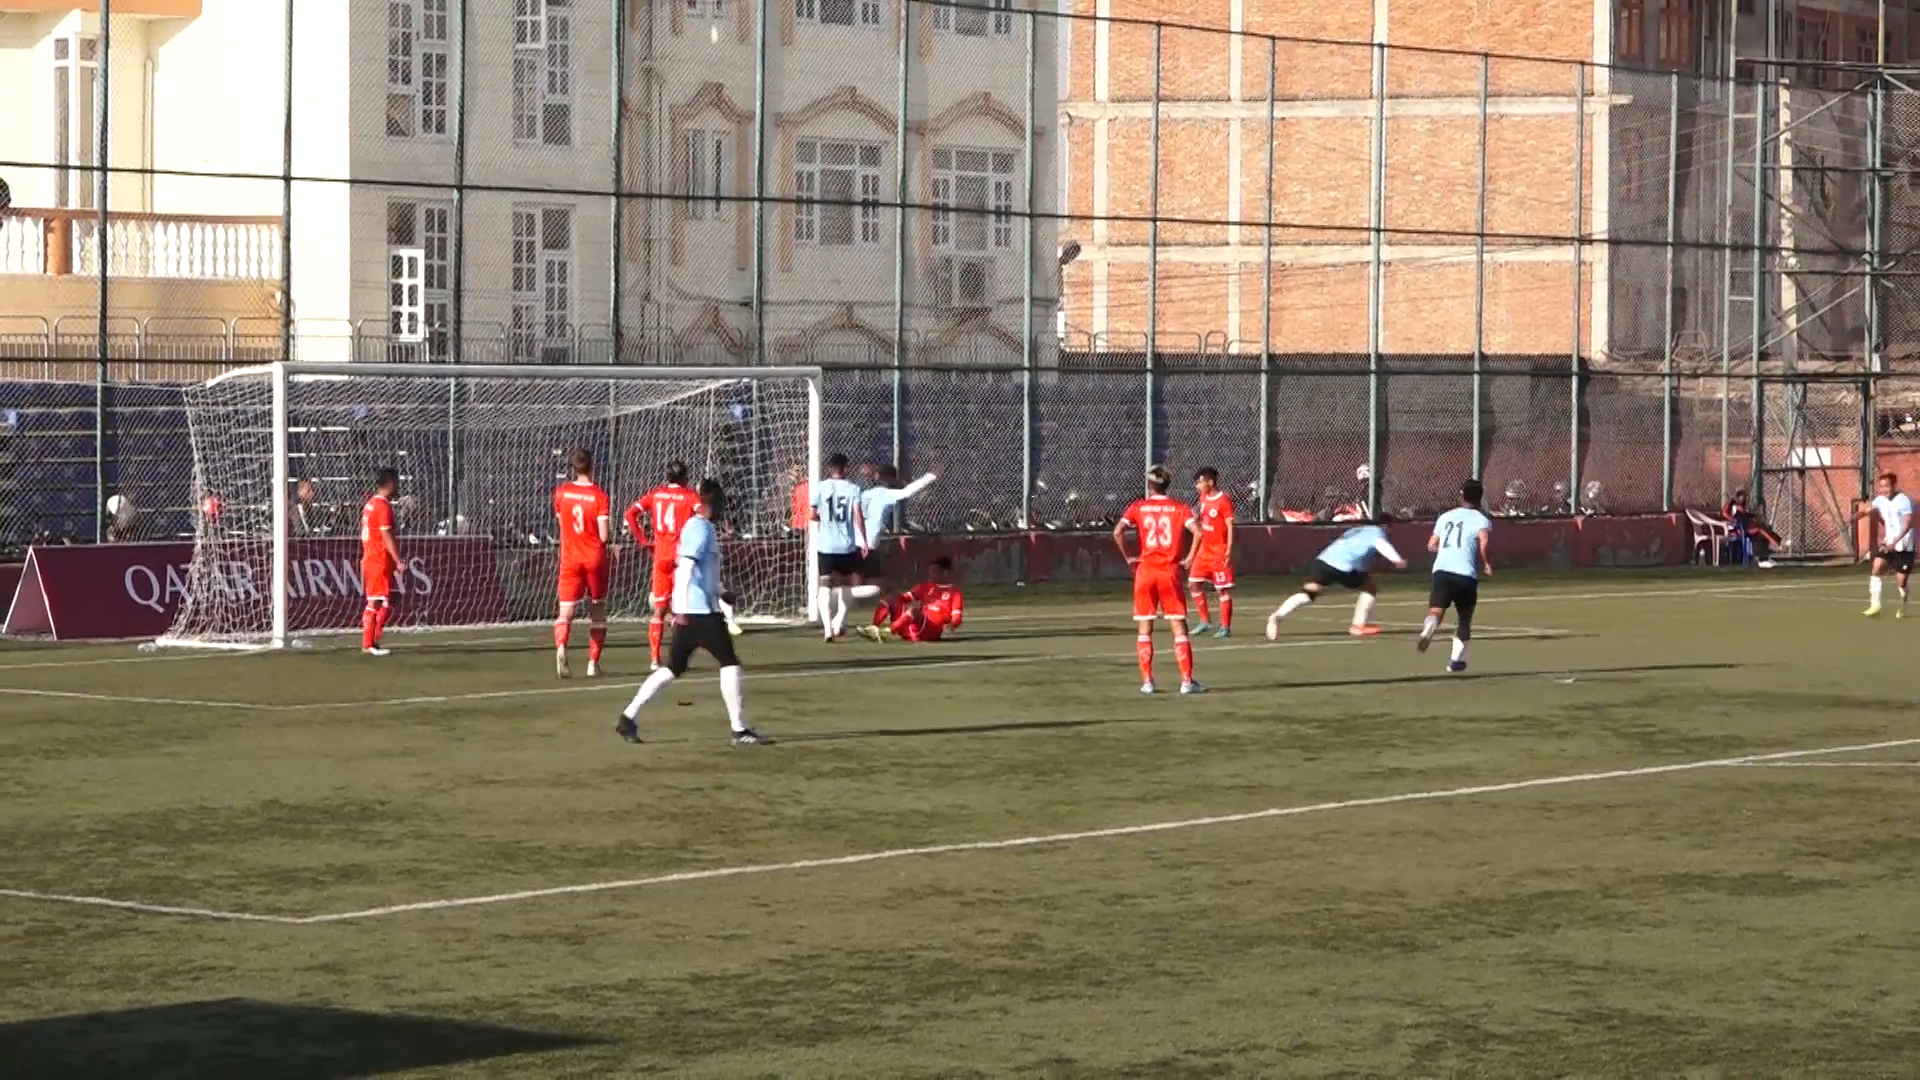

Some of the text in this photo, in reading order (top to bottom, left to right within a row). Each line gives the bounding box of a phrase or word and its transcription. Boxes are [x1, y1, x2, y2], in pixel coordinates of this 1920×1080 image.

[571, 503, 585, 535] 3
[655, 502, 677, 533] 14
[826, 494, 848, 522] 15
[1143, 515, 1172, 548] 23
[1442, 520, 1464, 549] 21
